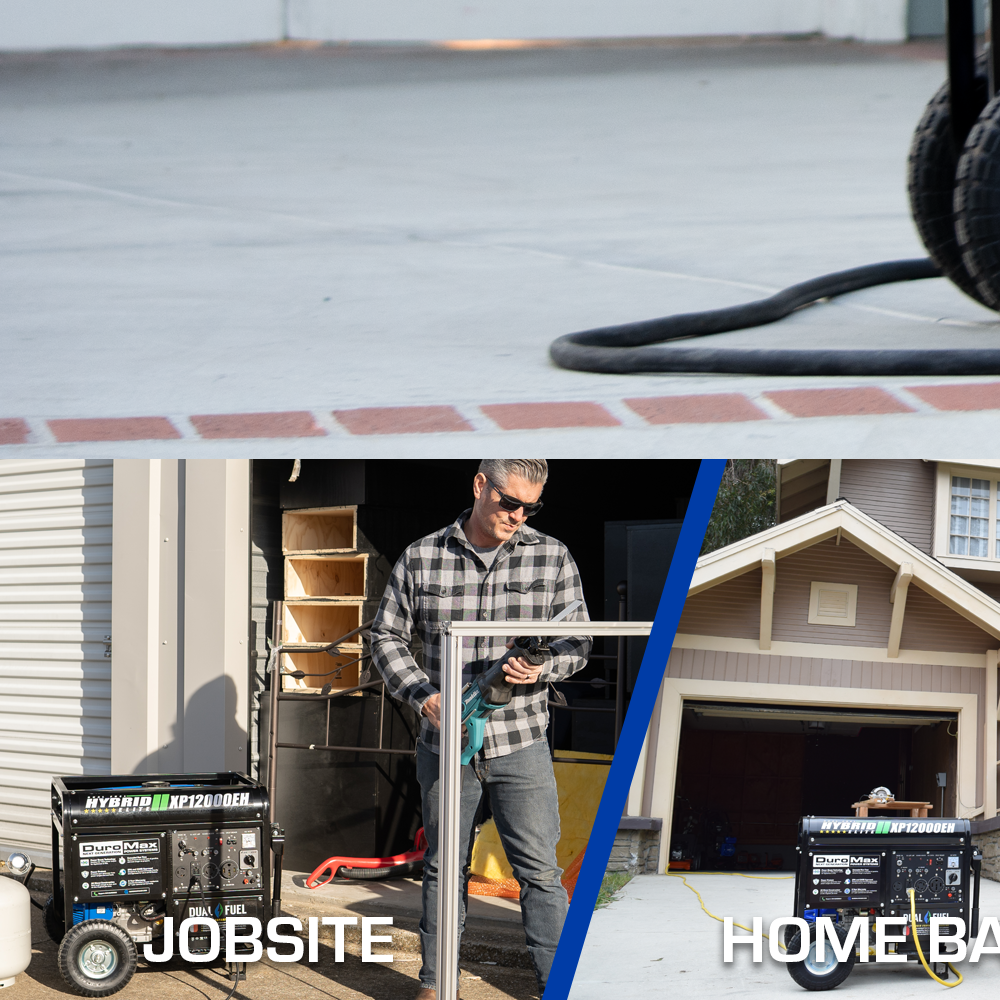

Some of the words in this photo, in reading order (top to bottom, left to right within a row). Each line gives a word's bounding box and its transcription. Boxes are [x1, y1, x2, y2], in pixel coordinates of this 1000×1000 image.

[85, 796, 152, 809] HYBRID
[169, 793, 250, 809] XP12000EH
[821, 821, 876, 830] HYBRID
[889, 823, 955, 834] XP12000EH
[189, 906, 213, 917] DUAL
[225, 904, 247, 915] FUEL
